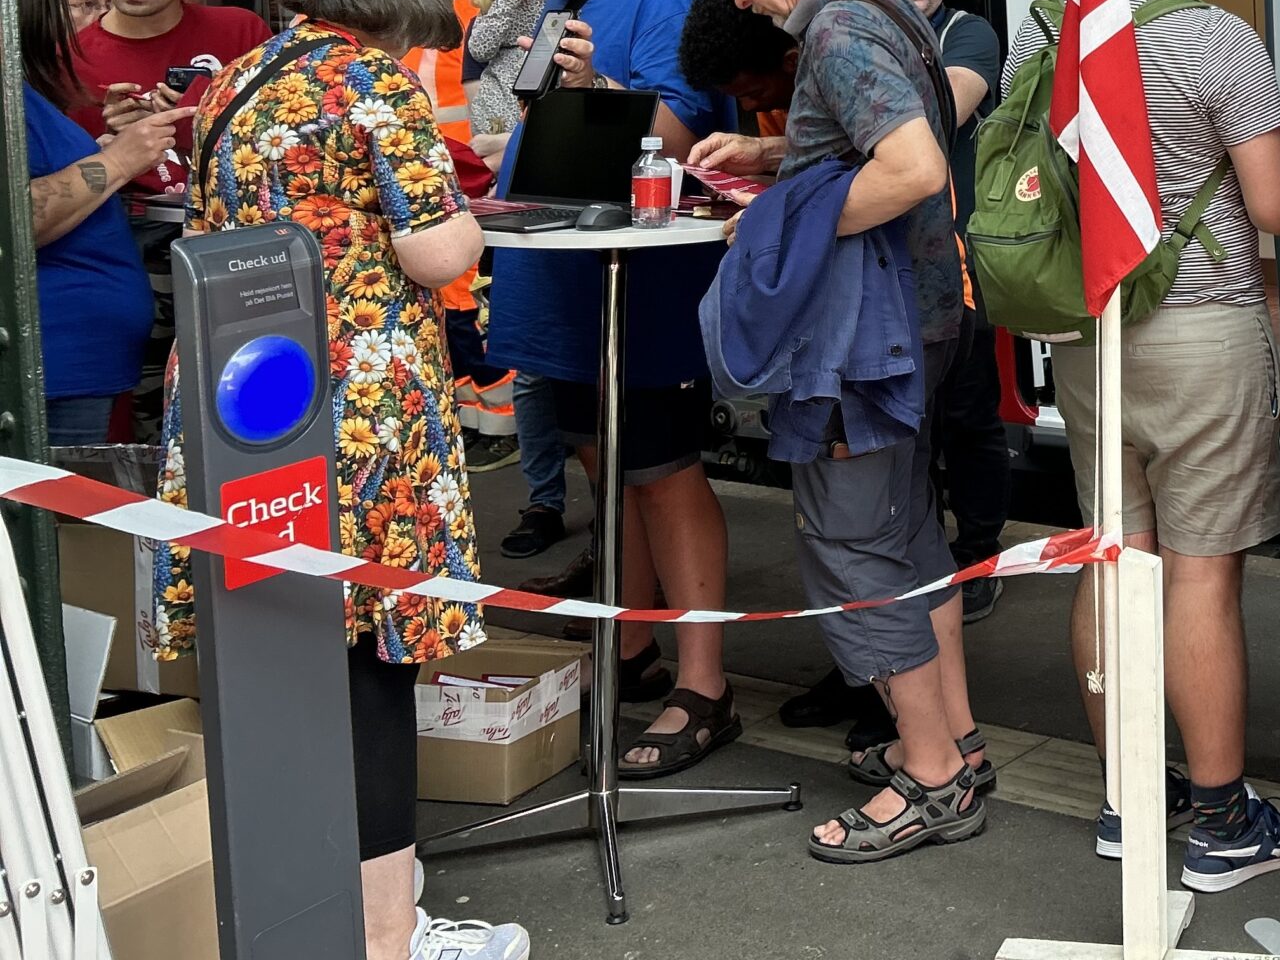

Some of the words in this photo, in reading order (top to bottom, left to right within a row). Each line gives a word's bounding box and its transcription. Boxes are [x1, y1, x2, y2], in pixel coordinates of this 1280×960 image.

[228, 256, 269, 272] Check
[271, 251, 287, 264] ud
[227, 482, 322, 528] Check
